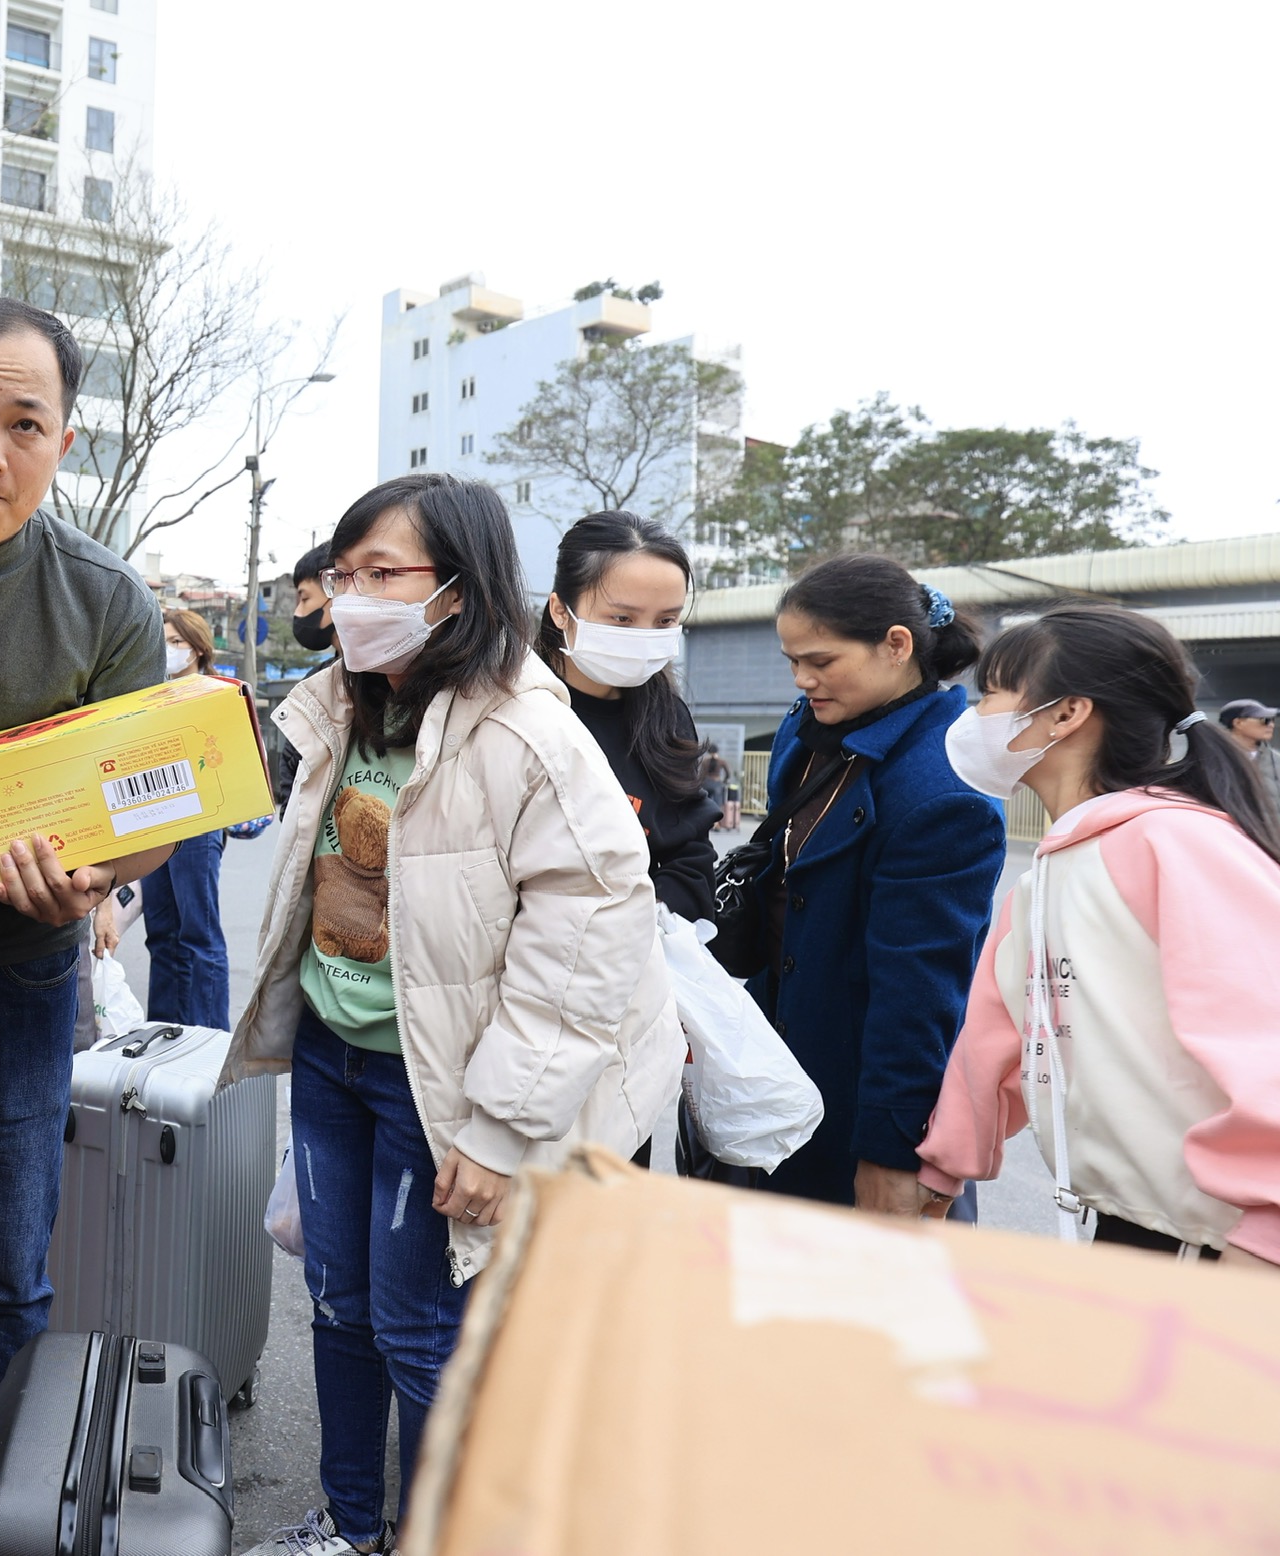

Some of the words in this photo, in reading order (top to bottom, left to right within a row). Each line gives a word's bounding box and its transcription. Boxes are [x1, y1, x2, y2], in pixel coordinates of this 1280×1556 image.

[347, 769, 391, 788] TEACH
[121, 794, 152, 806] 936036
[156, 784, 186, 798] 024746
[325, 963, 371, 984] TEACH
